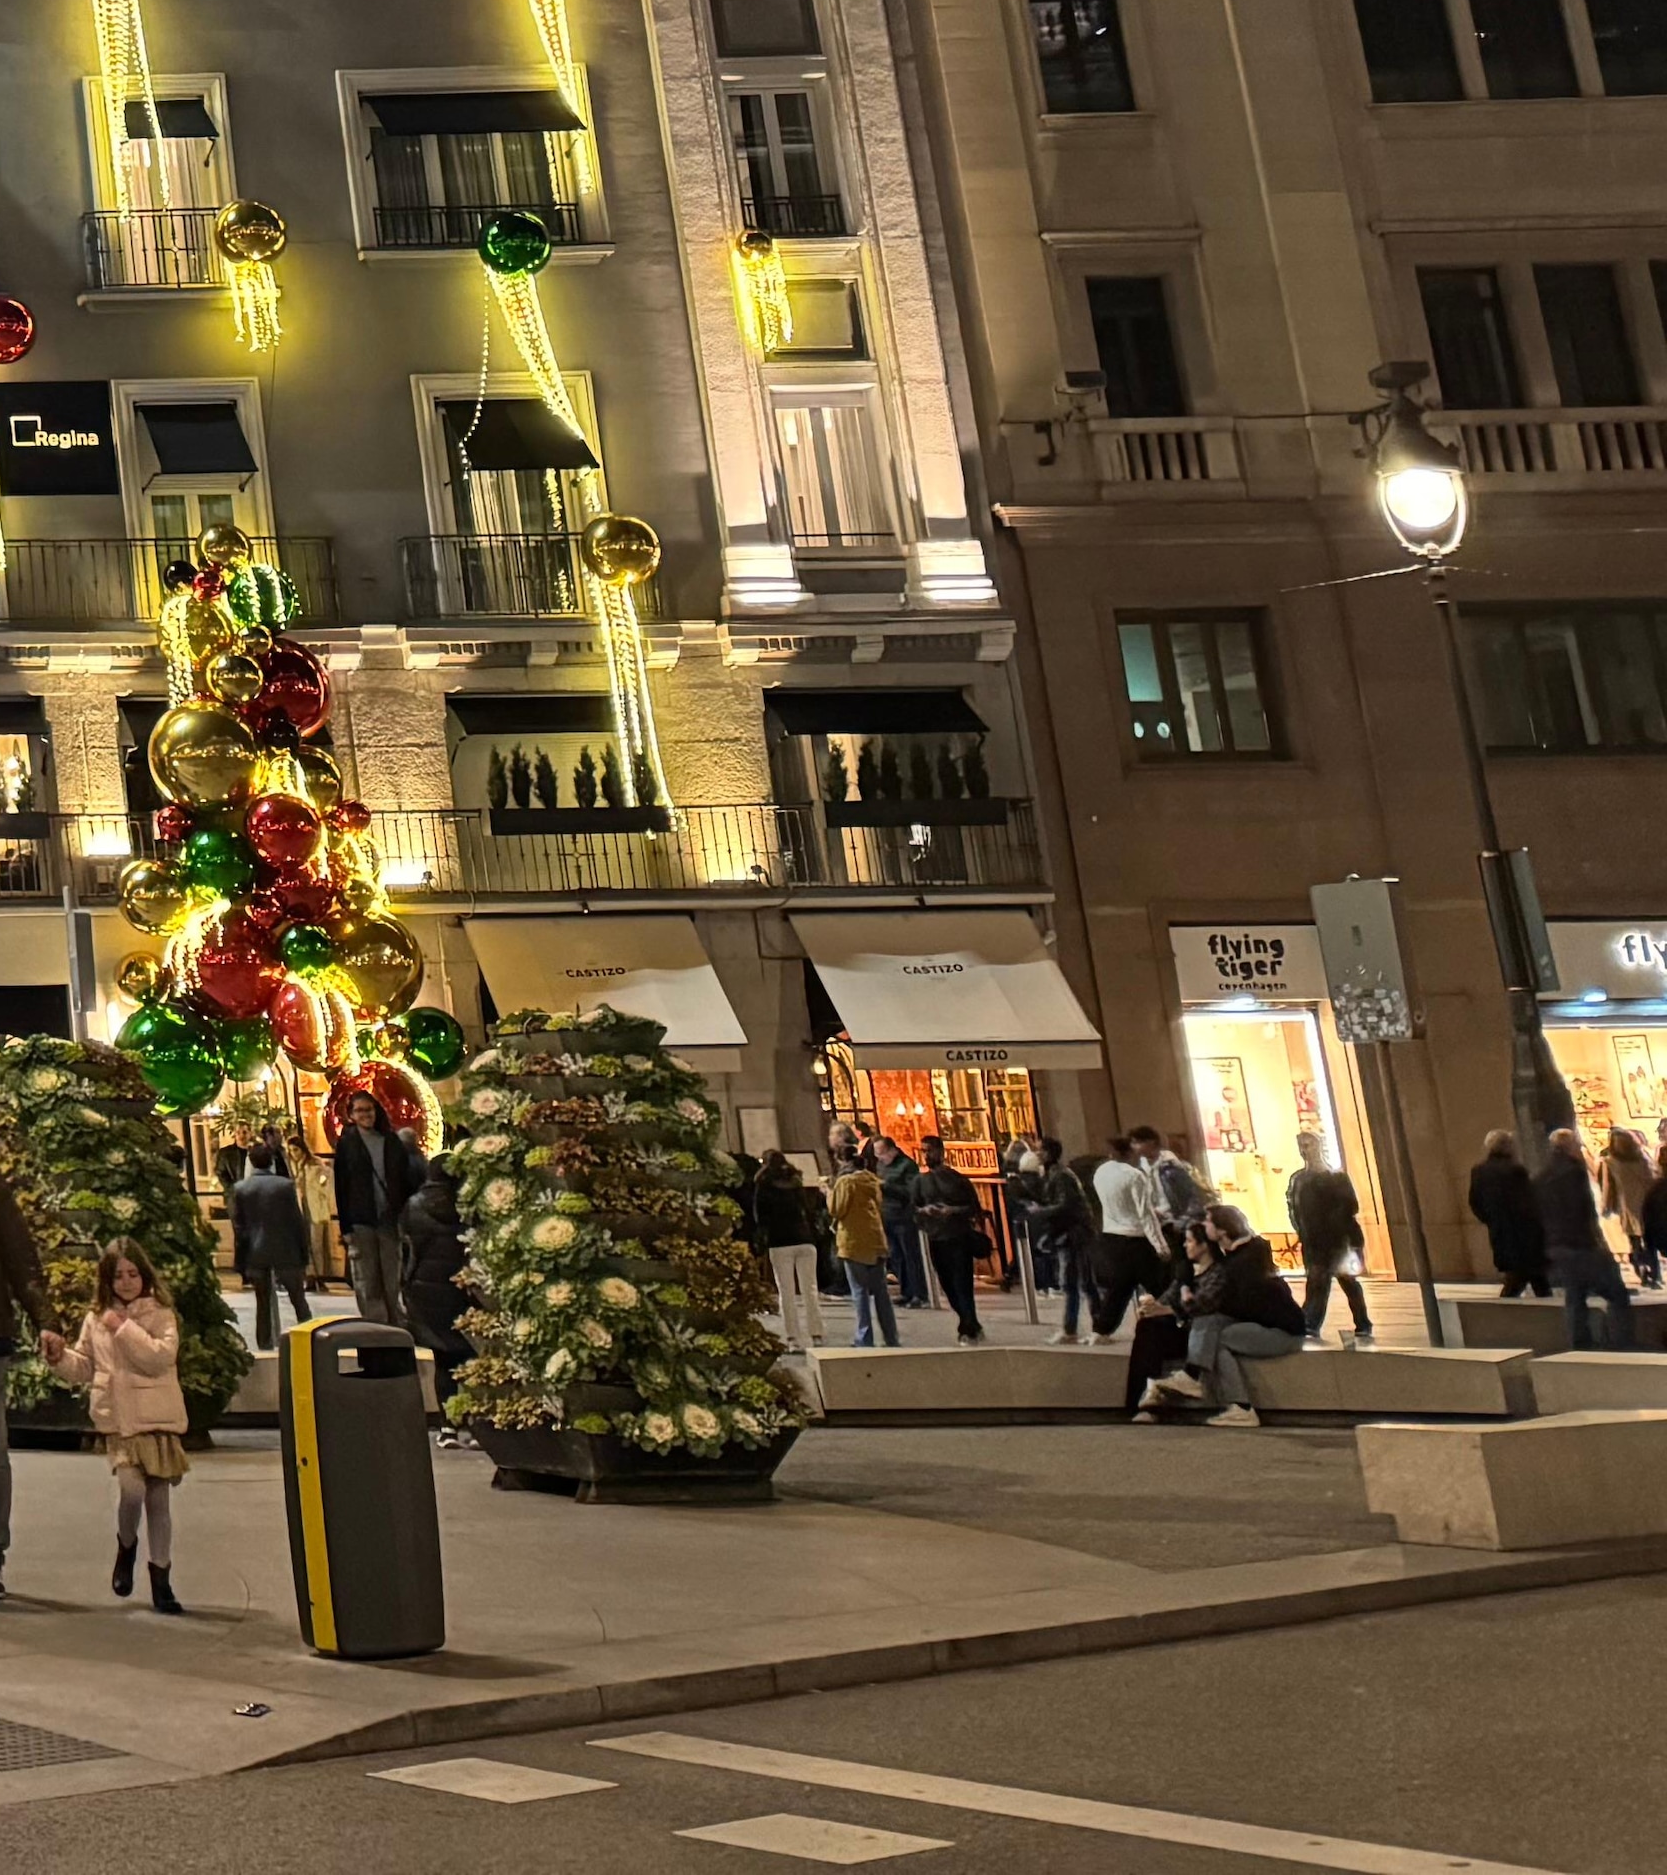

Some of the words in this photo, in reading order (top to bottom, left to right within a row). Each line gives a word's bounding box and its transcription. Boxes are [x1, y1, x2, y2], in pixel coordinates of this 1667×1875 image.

[34, 429, 100, 450] Regina
[1207, 933, 1285, 960] flying
[565, 967, 626, 978] CASTIZO
[903, 963, 964, 975] CASTIZO
[1214, 954, 1284, 981] tiger
[945, 1049, 1009, 1062] CASTIZO
